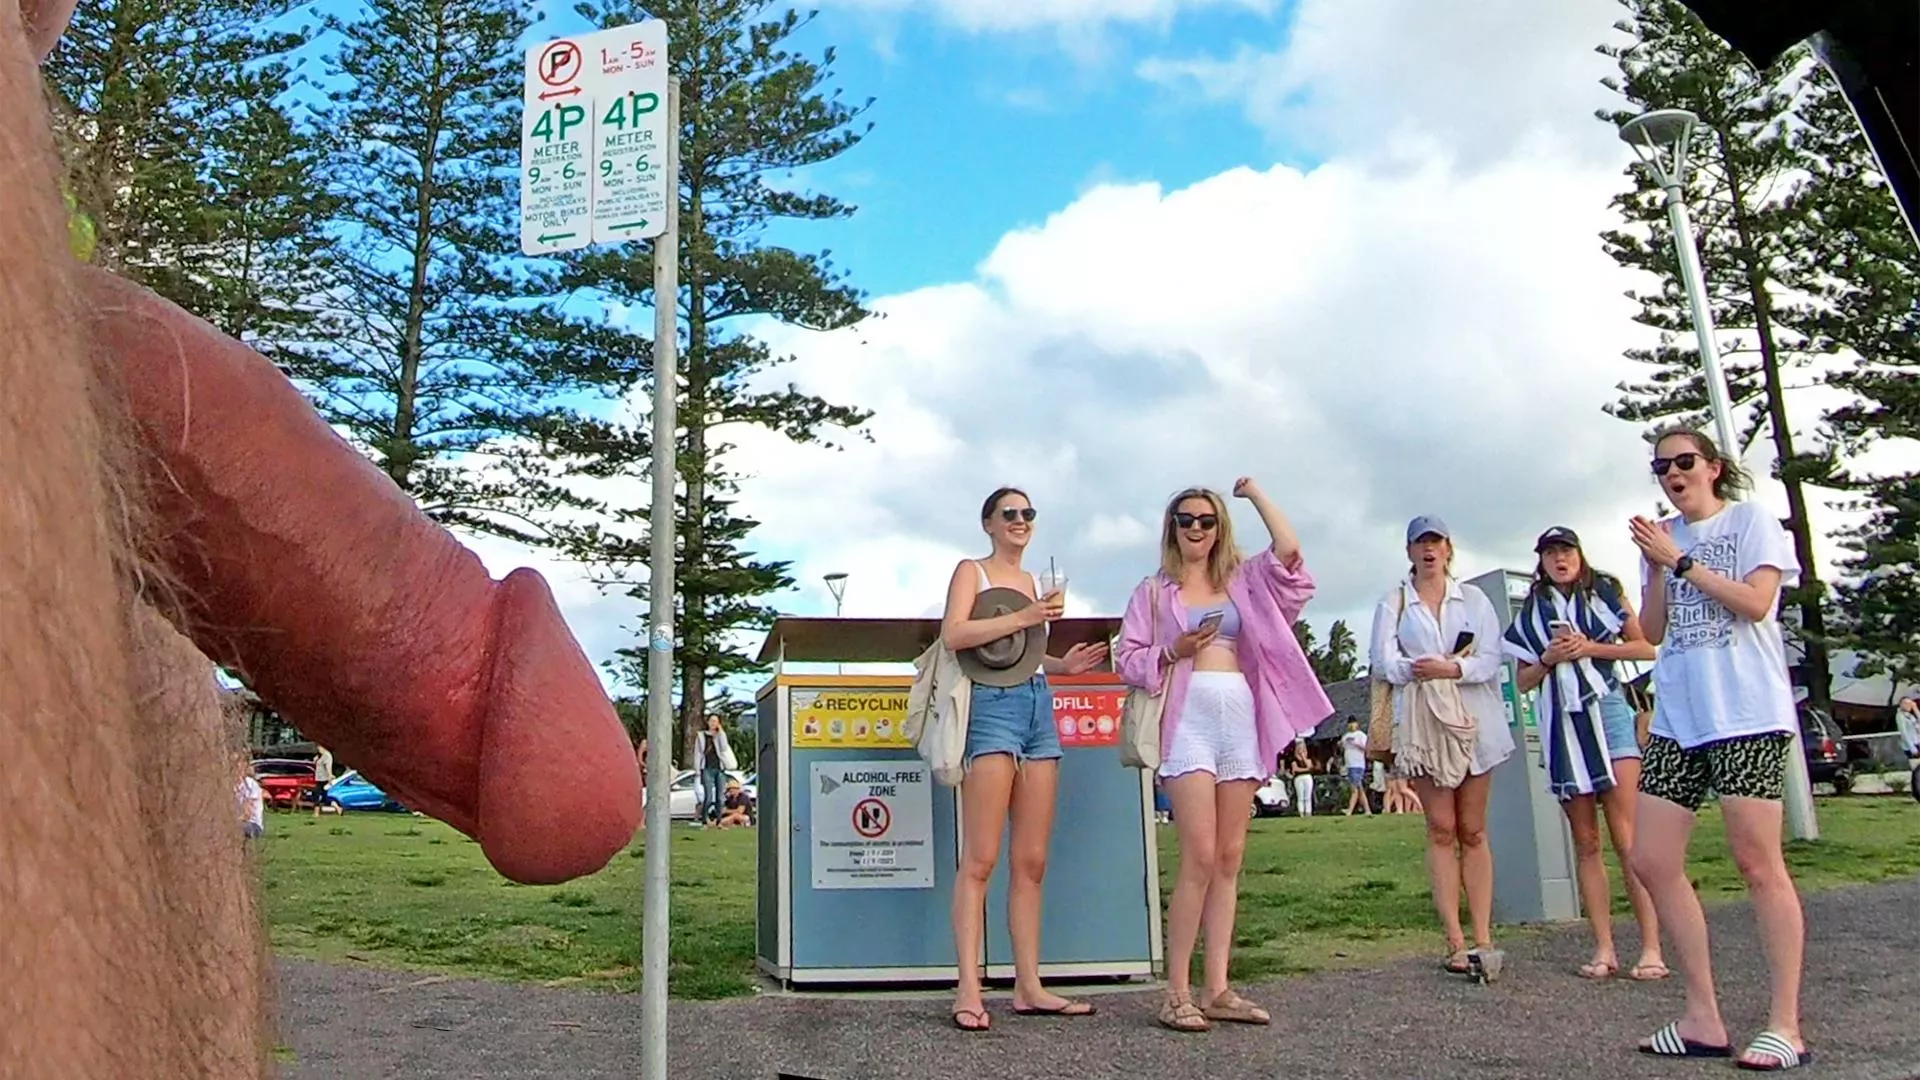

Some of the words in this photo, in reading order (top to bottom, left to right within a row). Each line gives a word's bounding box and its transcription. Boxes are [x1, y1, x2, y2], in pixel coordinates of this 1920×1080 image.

[602, 64, 623, 74] MON
[635, 58, 655, 69] SUN
[602, 92, 659, 130] 4P
[530, 105, 585, 143] 4P
[605, 130, 653, 147] METER
[533, 141, 579, 158] METER
[602, 144, 657, 157] REGISTRATION
[531, 185, 551, 194] MON
[563, 181, 582, 190] SUN
[603, 178, 624, 187] MON
[636, 173, 656, 183] SUN
[525, 210, 556, 222] MOTOR
[560, 206, 588, 217] BIKES
[543, 218, 568, 228] ONLY
[842, 772, 922, 783] ALCOHOL-FREE
[868, 786, 896, 797] ZONE
